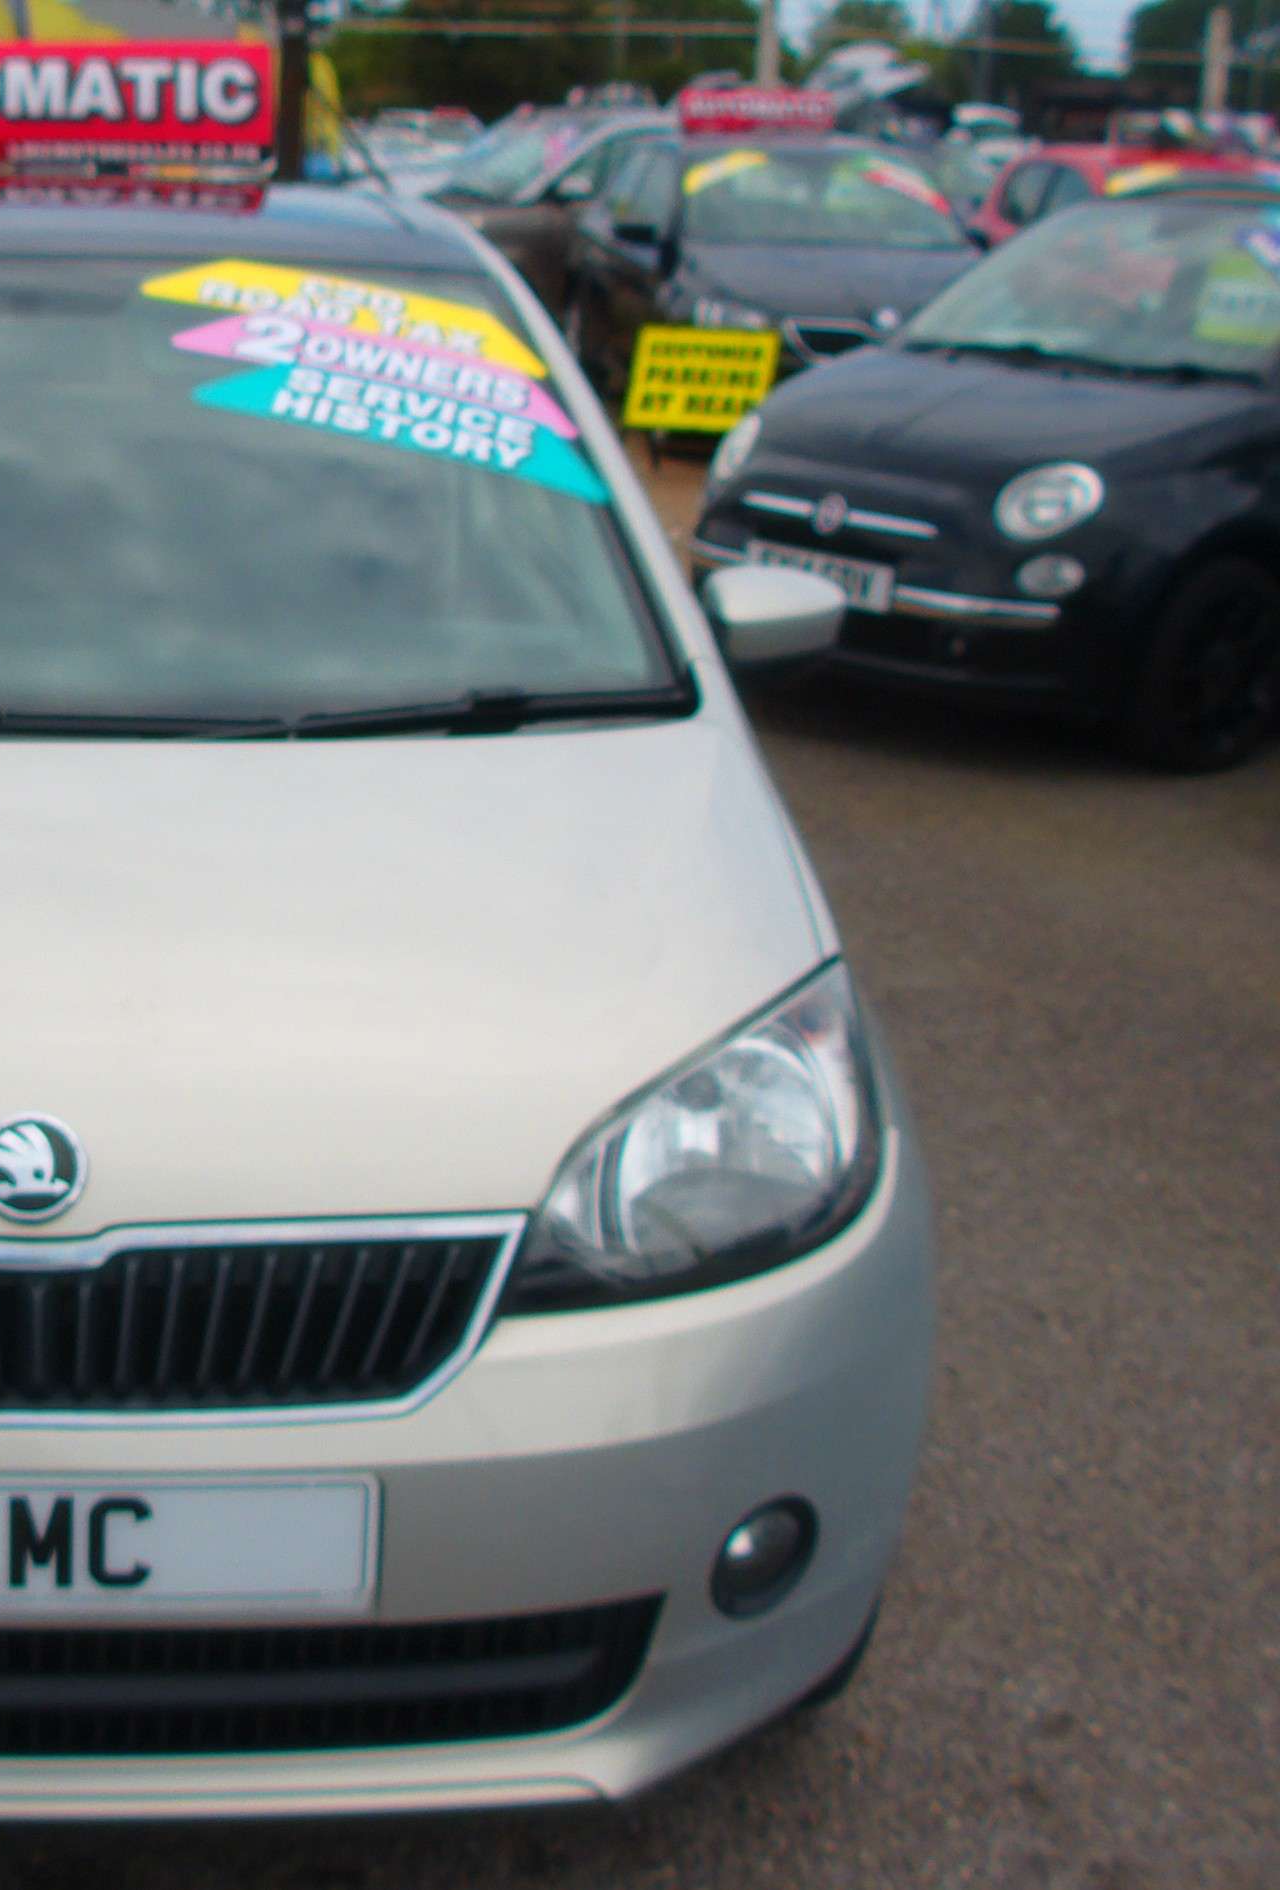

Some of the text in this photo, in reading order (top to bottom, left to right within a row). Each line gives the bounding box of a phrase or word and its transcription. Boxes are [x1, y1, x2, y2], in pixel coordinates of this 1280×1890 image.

[198, 278, 484, 358] ROAD TAX
[231, 314, 532, 411] 2 OWNERS
[640, 392, 673, 412] AT
[647, 366, 761, 389] PARKING
[272, 390, 535, 468] HISTORY
[287, 368, 536, 448] SERVICE
